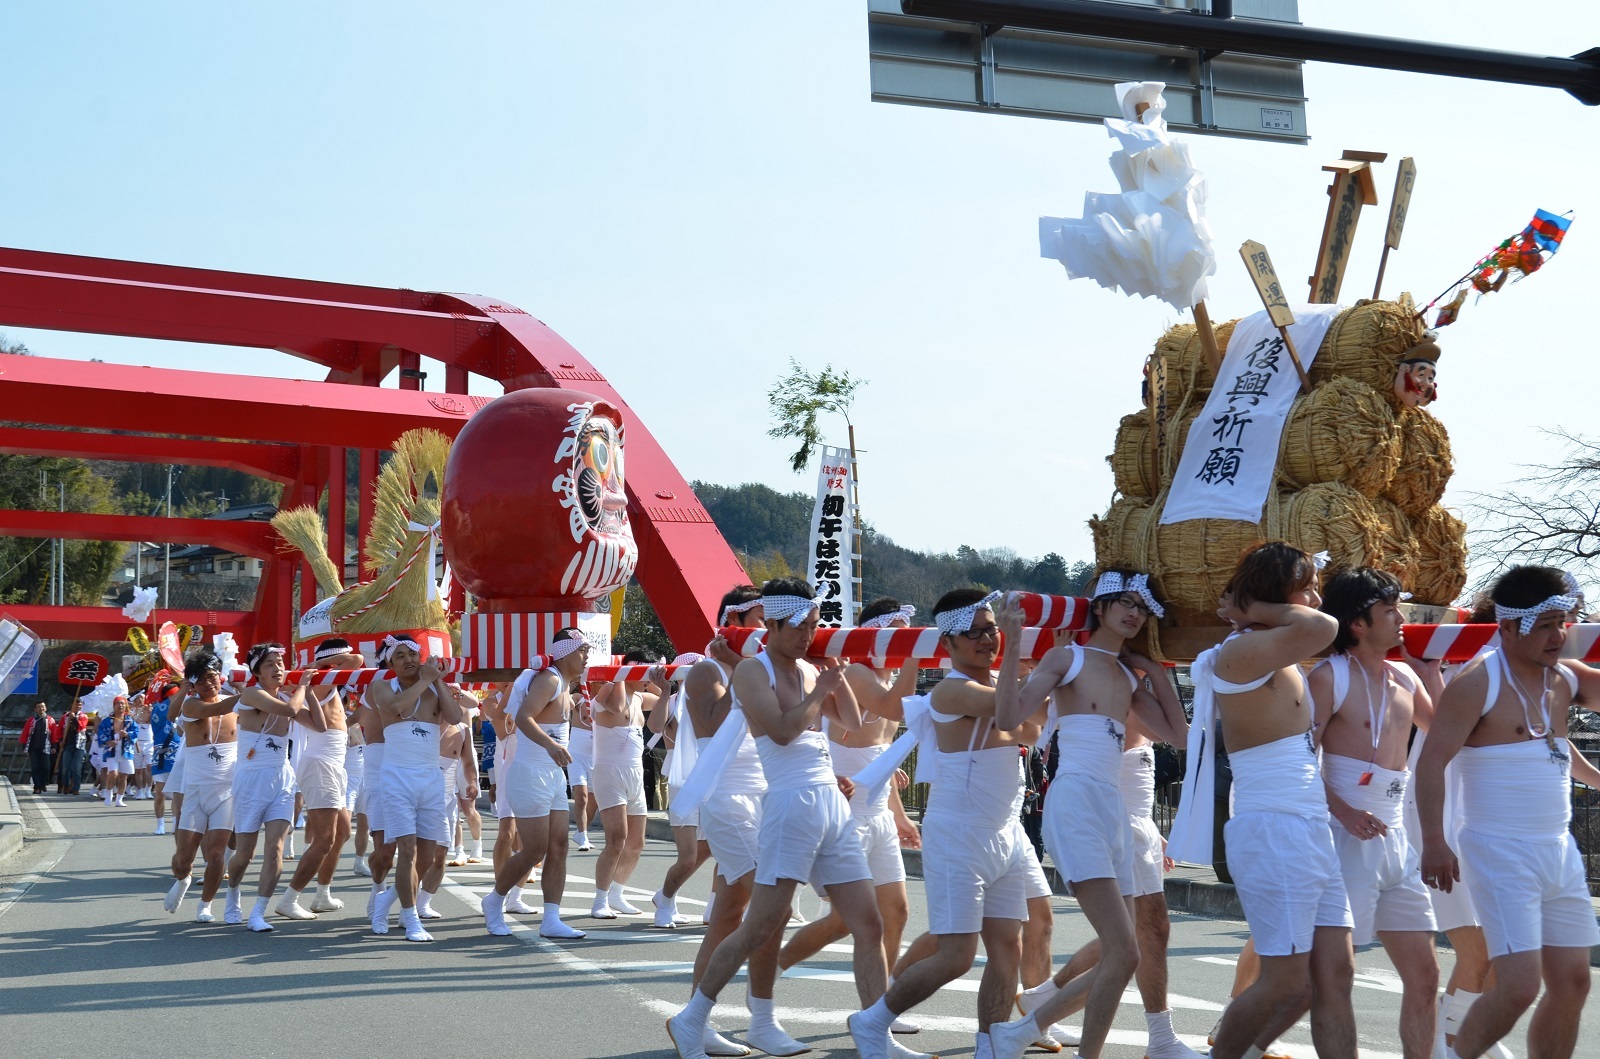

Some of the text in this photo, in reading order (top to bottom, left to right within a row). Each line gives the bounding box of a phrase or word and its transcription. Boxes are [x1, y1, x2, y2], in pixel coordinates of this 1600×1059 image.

[815, 493, 846, 628] 初午はだか祭
[66, 659, 99, 681] 祭
